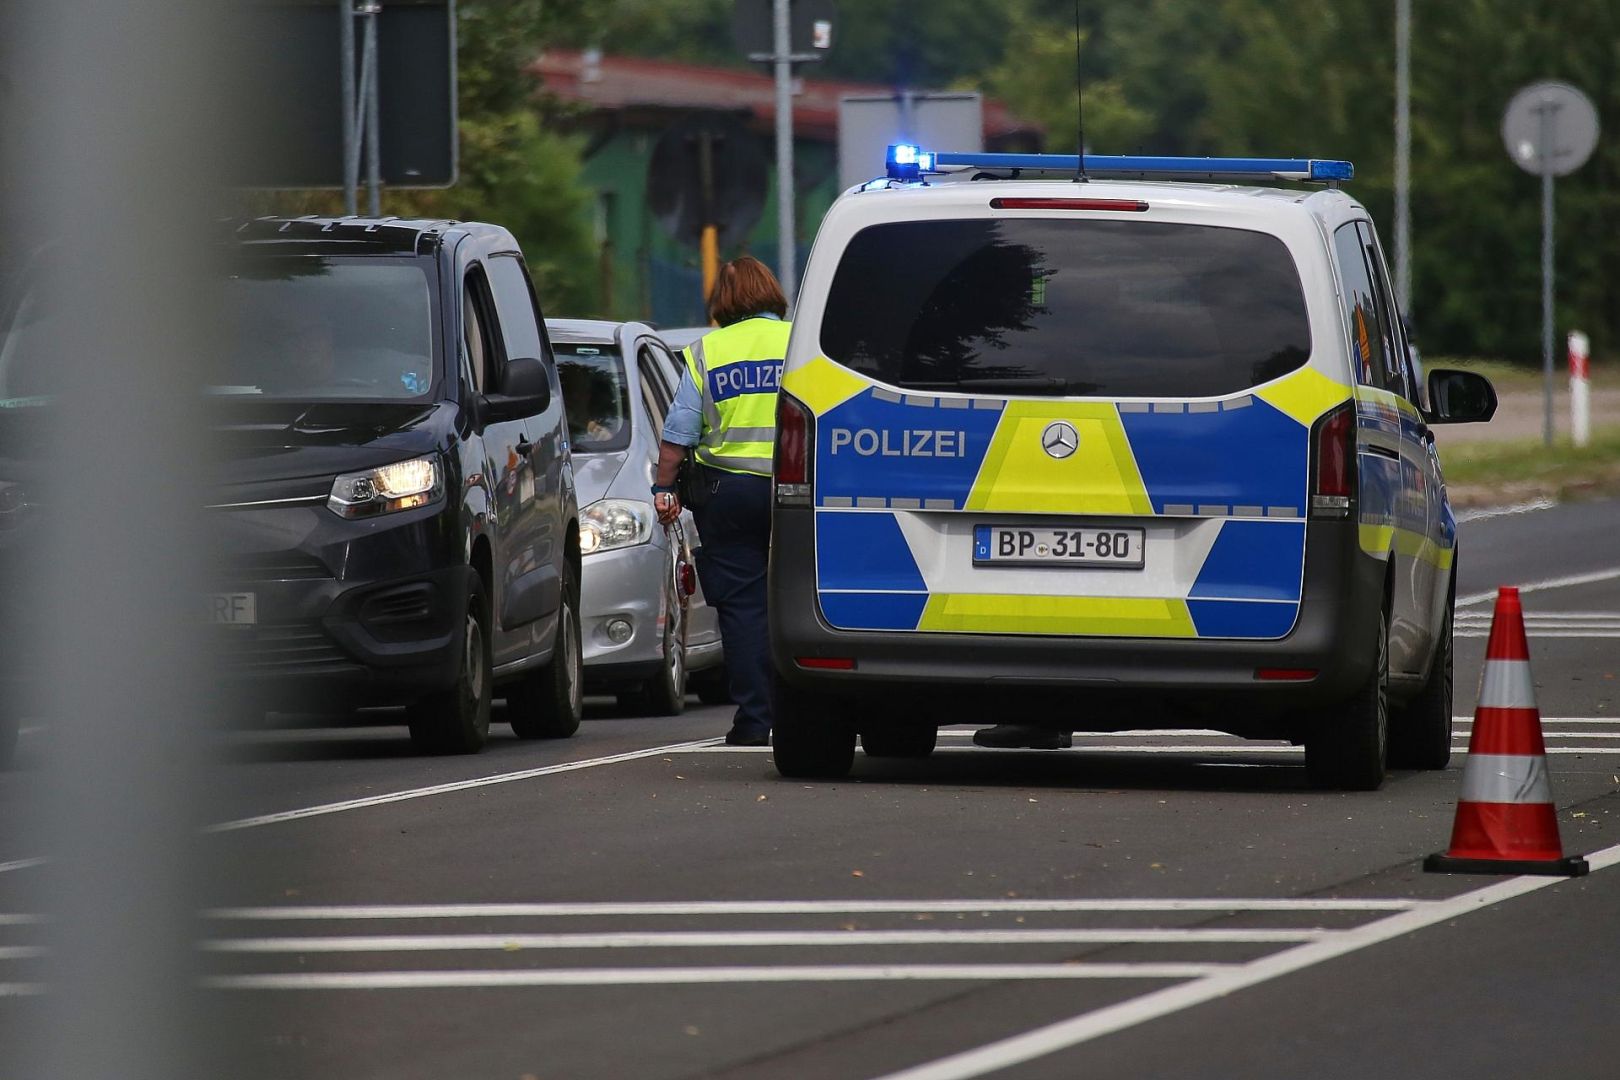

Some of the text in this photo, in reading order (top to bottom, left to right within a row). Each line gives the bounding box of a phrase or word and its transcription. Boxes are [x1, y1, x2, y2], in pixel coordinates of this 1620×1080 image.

[715, 365, 783, 394] POLIZE
[831, 428, 965, 457] POLIZEI
[980, 531, 1129, 558] D BP 31-80
[204, 595, 247, 621] RF
